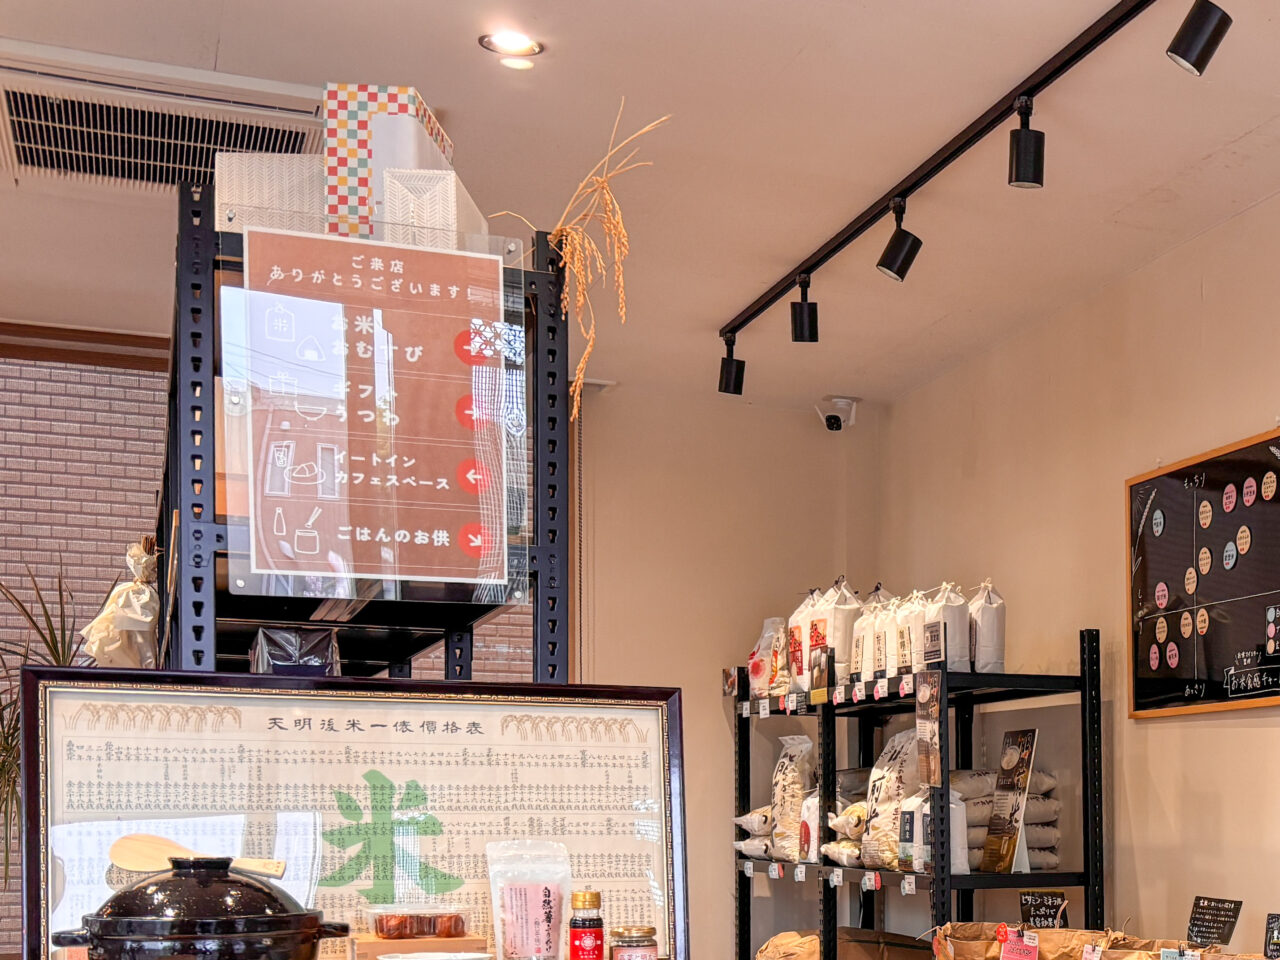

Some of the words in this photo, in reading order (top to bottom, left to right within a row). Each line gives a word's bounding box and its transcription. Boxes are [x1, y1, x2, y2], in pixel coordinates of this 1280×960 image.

[352, 255, 404, 274] ご来店
[269, 264, 473, 301] ありがとうございます!
[331, 315, 375, 335] お米
[335, 409, 400, 427] うつわ
[335, 453, 416, 468] イートイン
[334, 472, 451, 491] カフェスペース
[1184, 473, 1206, 489] もっちり
[336, 526, 451, 547] ごはんのお供
[1185, 683, 1206, 697] あっさり
[320, 770, 466, 905] 米
